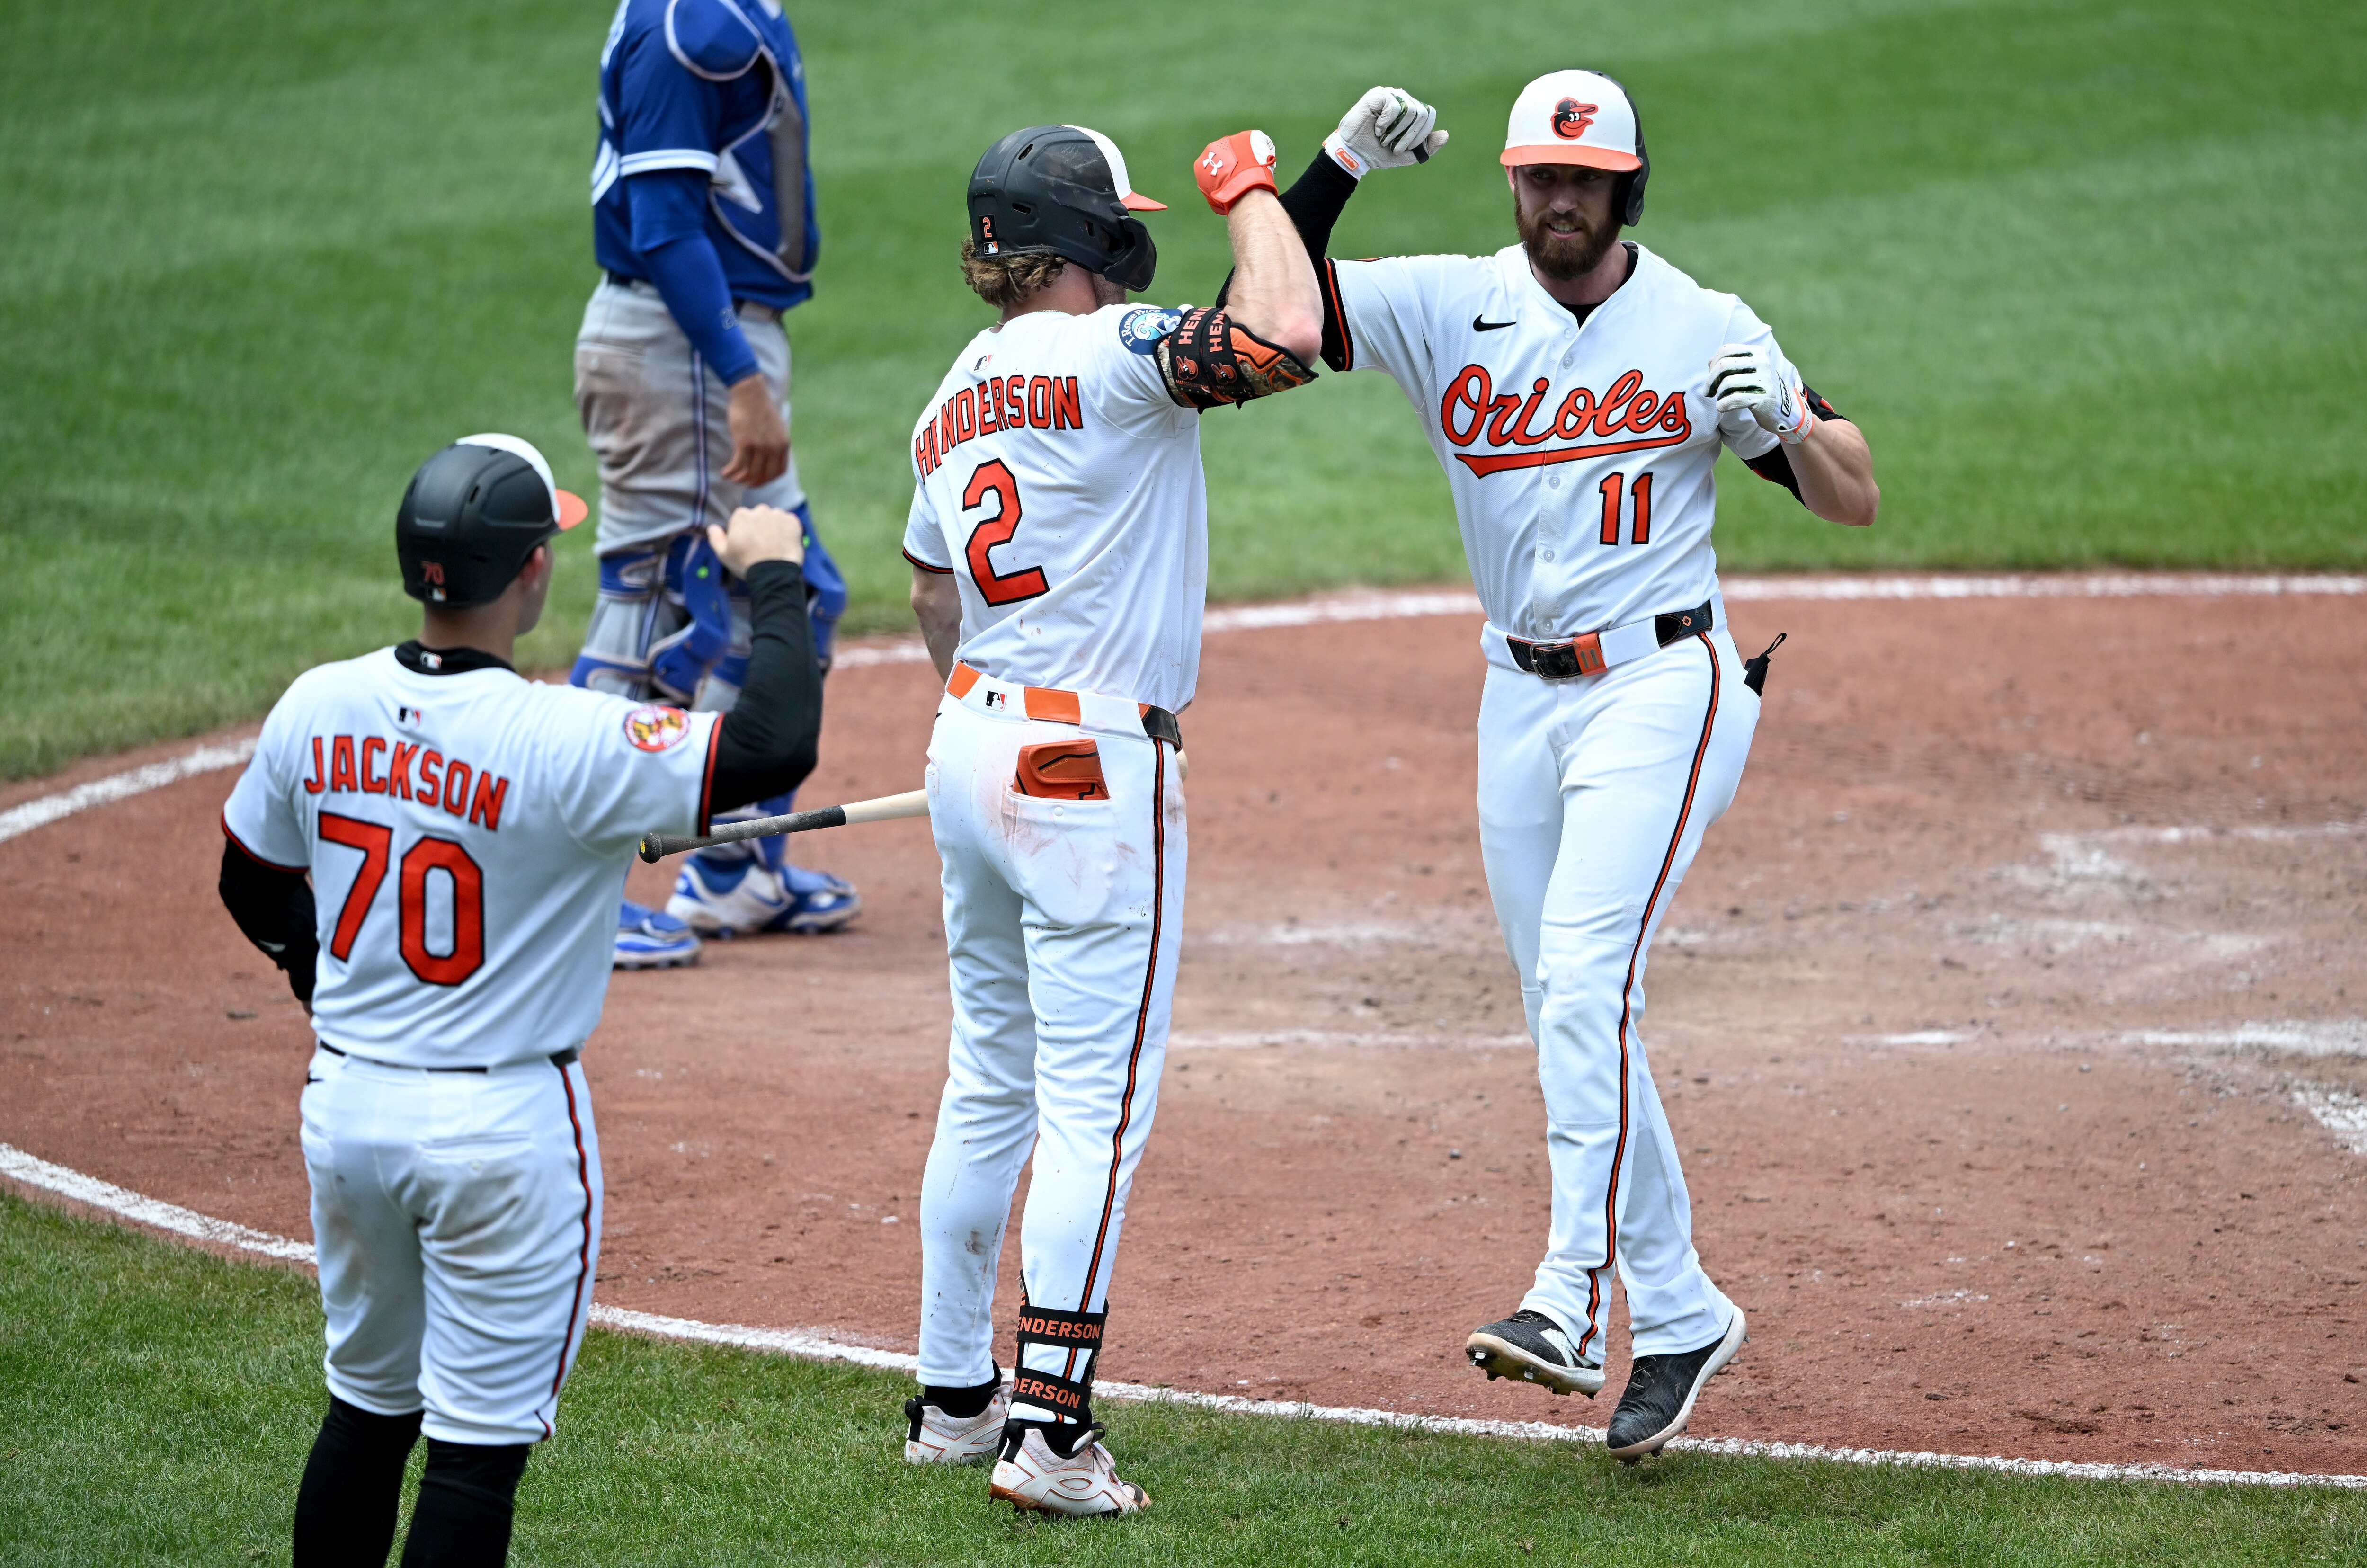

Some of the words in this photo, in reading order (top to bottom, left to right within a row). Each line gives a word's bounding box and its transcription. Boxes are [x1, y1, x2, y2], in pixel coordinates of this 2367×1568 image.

[982, 217, 992, 238] 2
[1209, 310, 1225, 352] HEN
[1441, 364, 1691, 446] Orioles
[962, 457, 1050, 608] 2
[1599, 472, 1654, 546] 11
[421, 561, 445, 585] 70
[303, 734, 509, 831] JACKSON
[318, 810, 485, 987] 70
